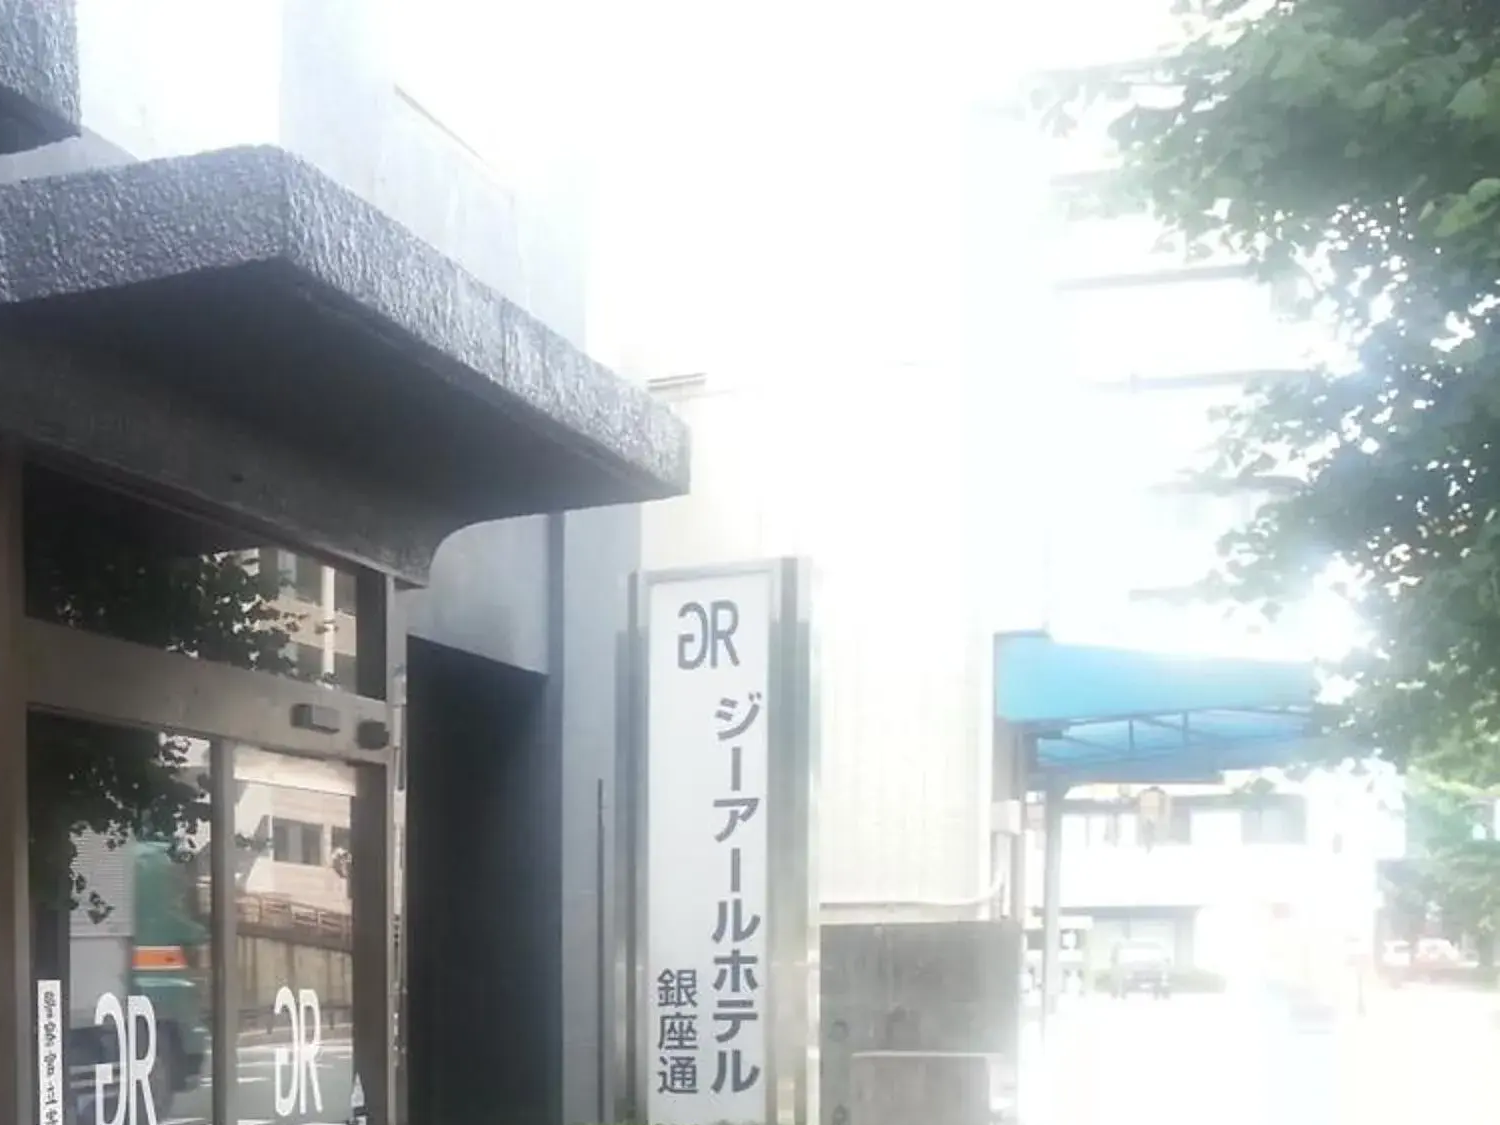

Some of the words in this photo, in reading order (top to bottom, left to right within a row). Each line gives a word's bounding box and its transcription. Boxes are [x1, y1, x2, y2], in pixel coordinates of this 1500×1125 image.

[711, 691, 762, 1093] ジーアールホテル
[656, 967, 698, 1096] 銀座通
